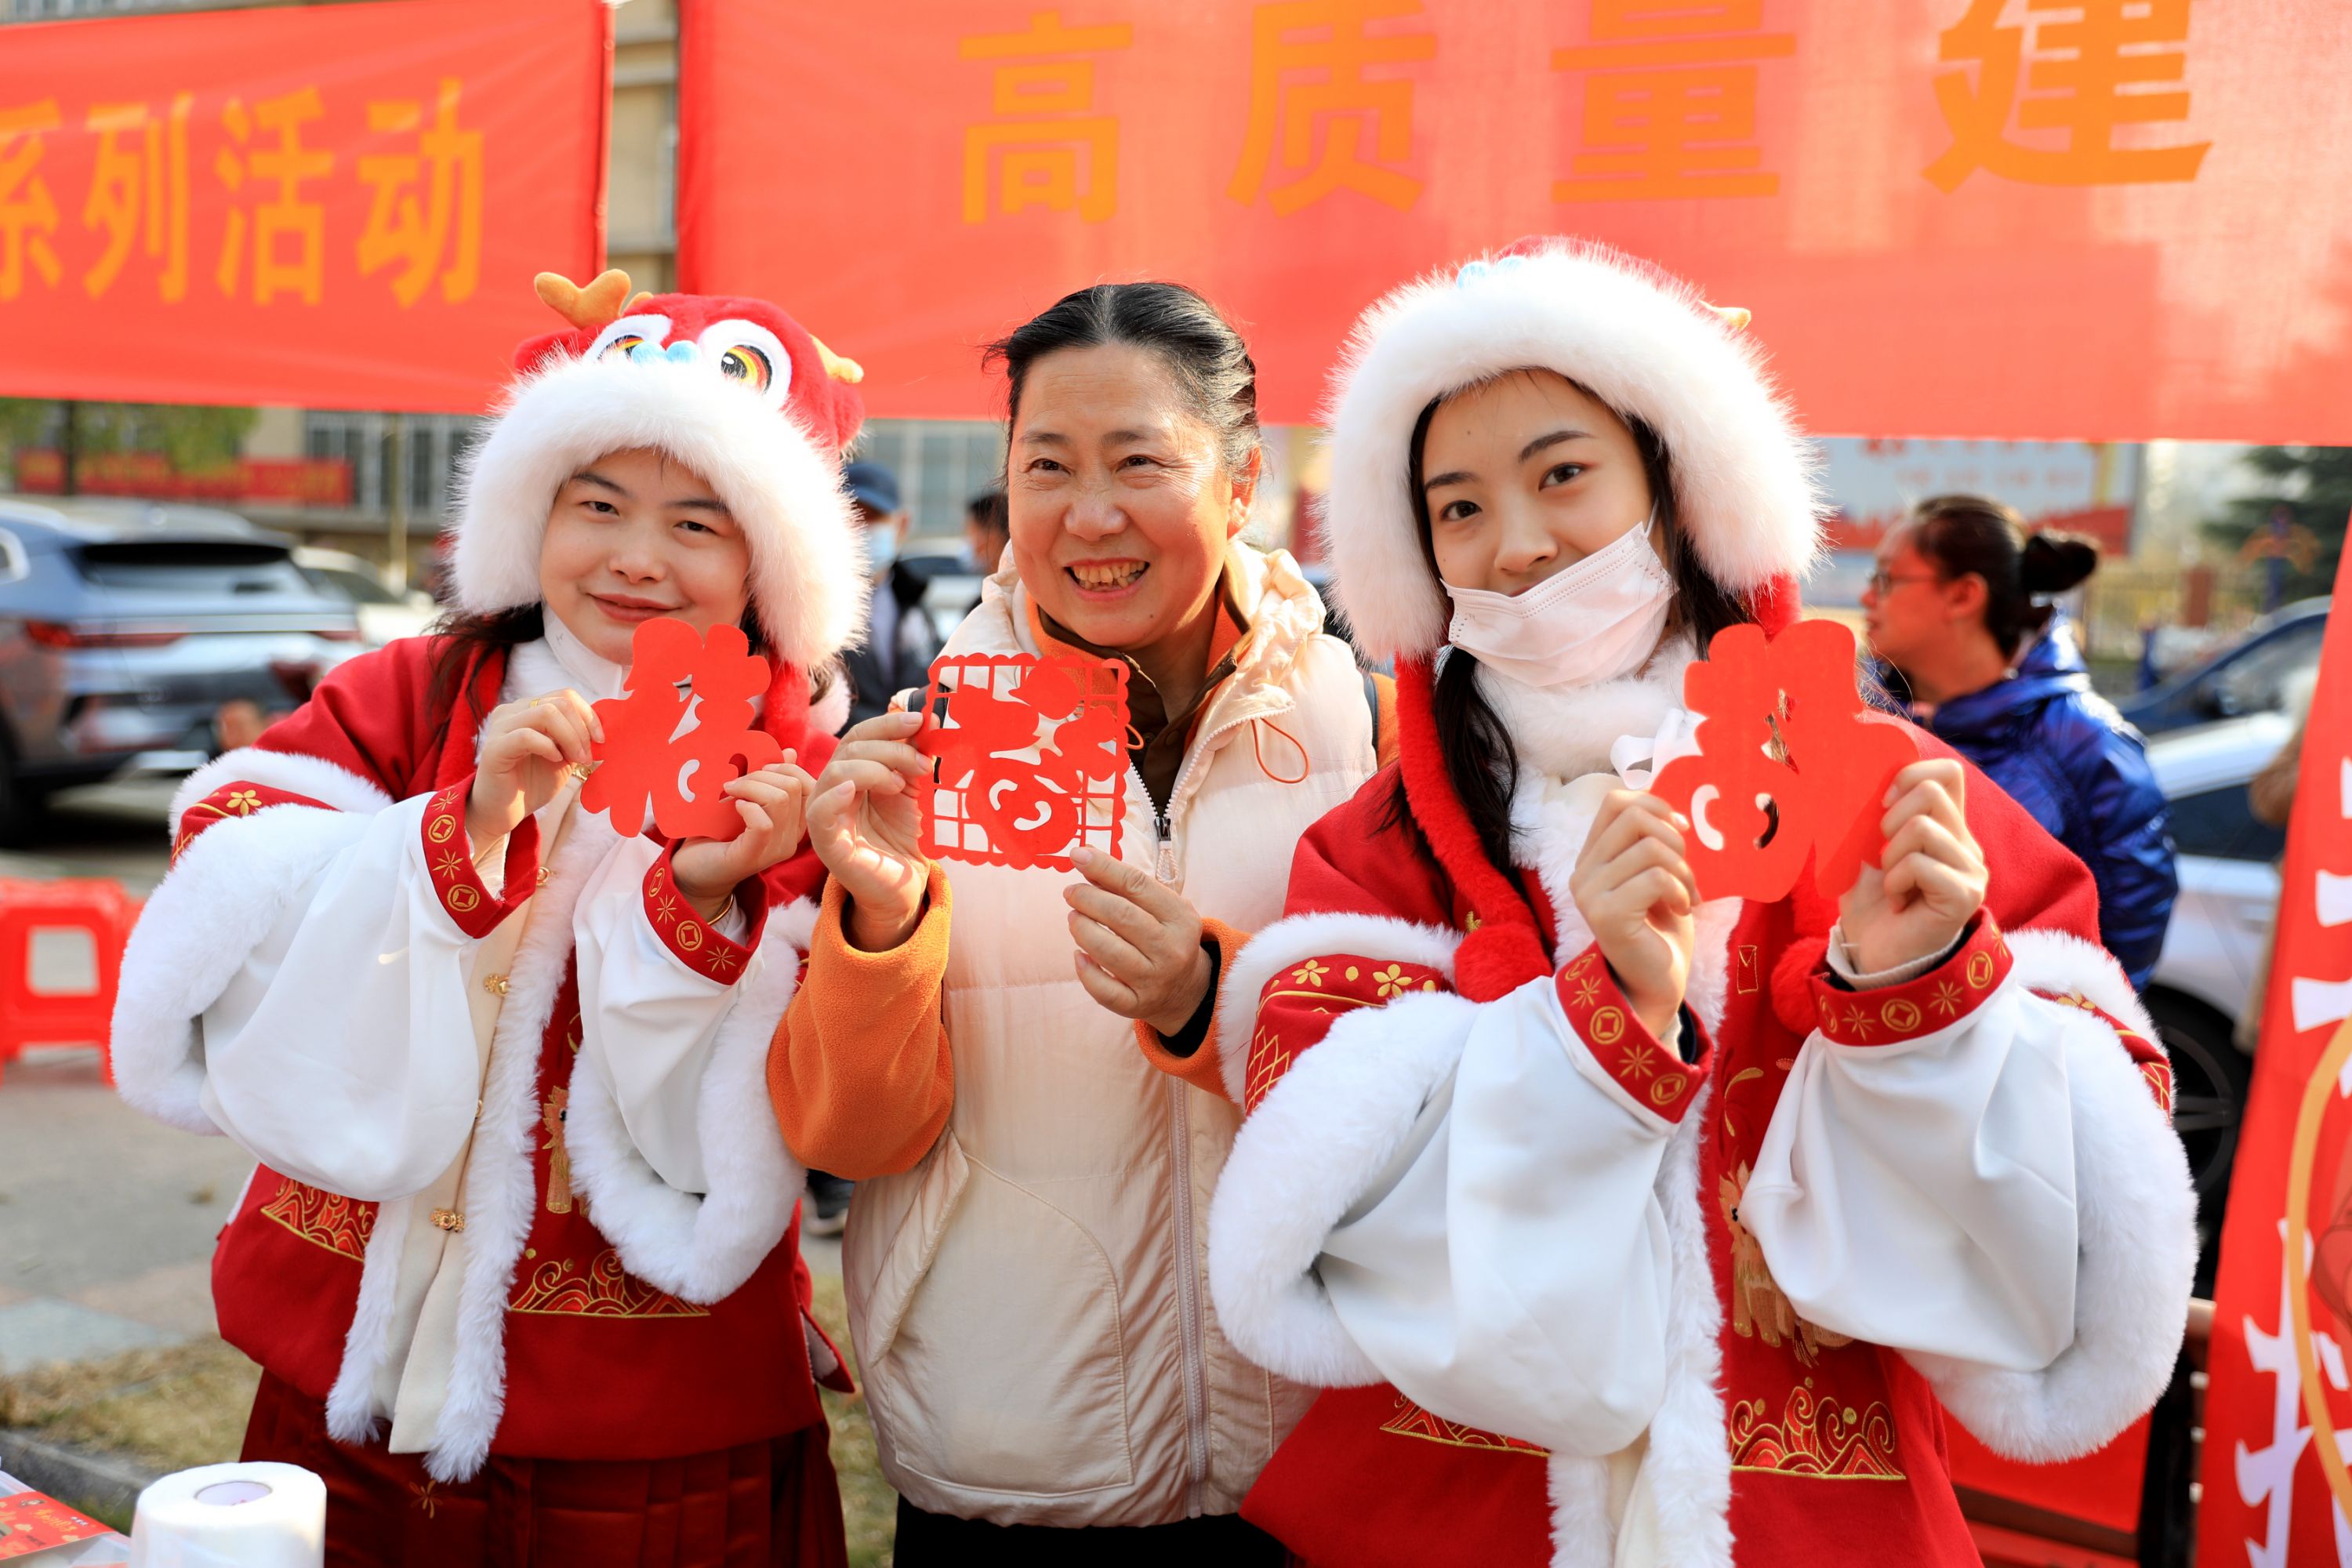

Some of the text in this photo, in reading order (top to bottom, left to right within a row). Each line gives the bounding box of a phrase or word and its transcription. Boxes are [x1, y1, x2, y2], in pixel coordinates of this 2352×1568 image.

[0, 78, 485, 308] 系列活动
[958, 0, 2214, 226] 高质量建
